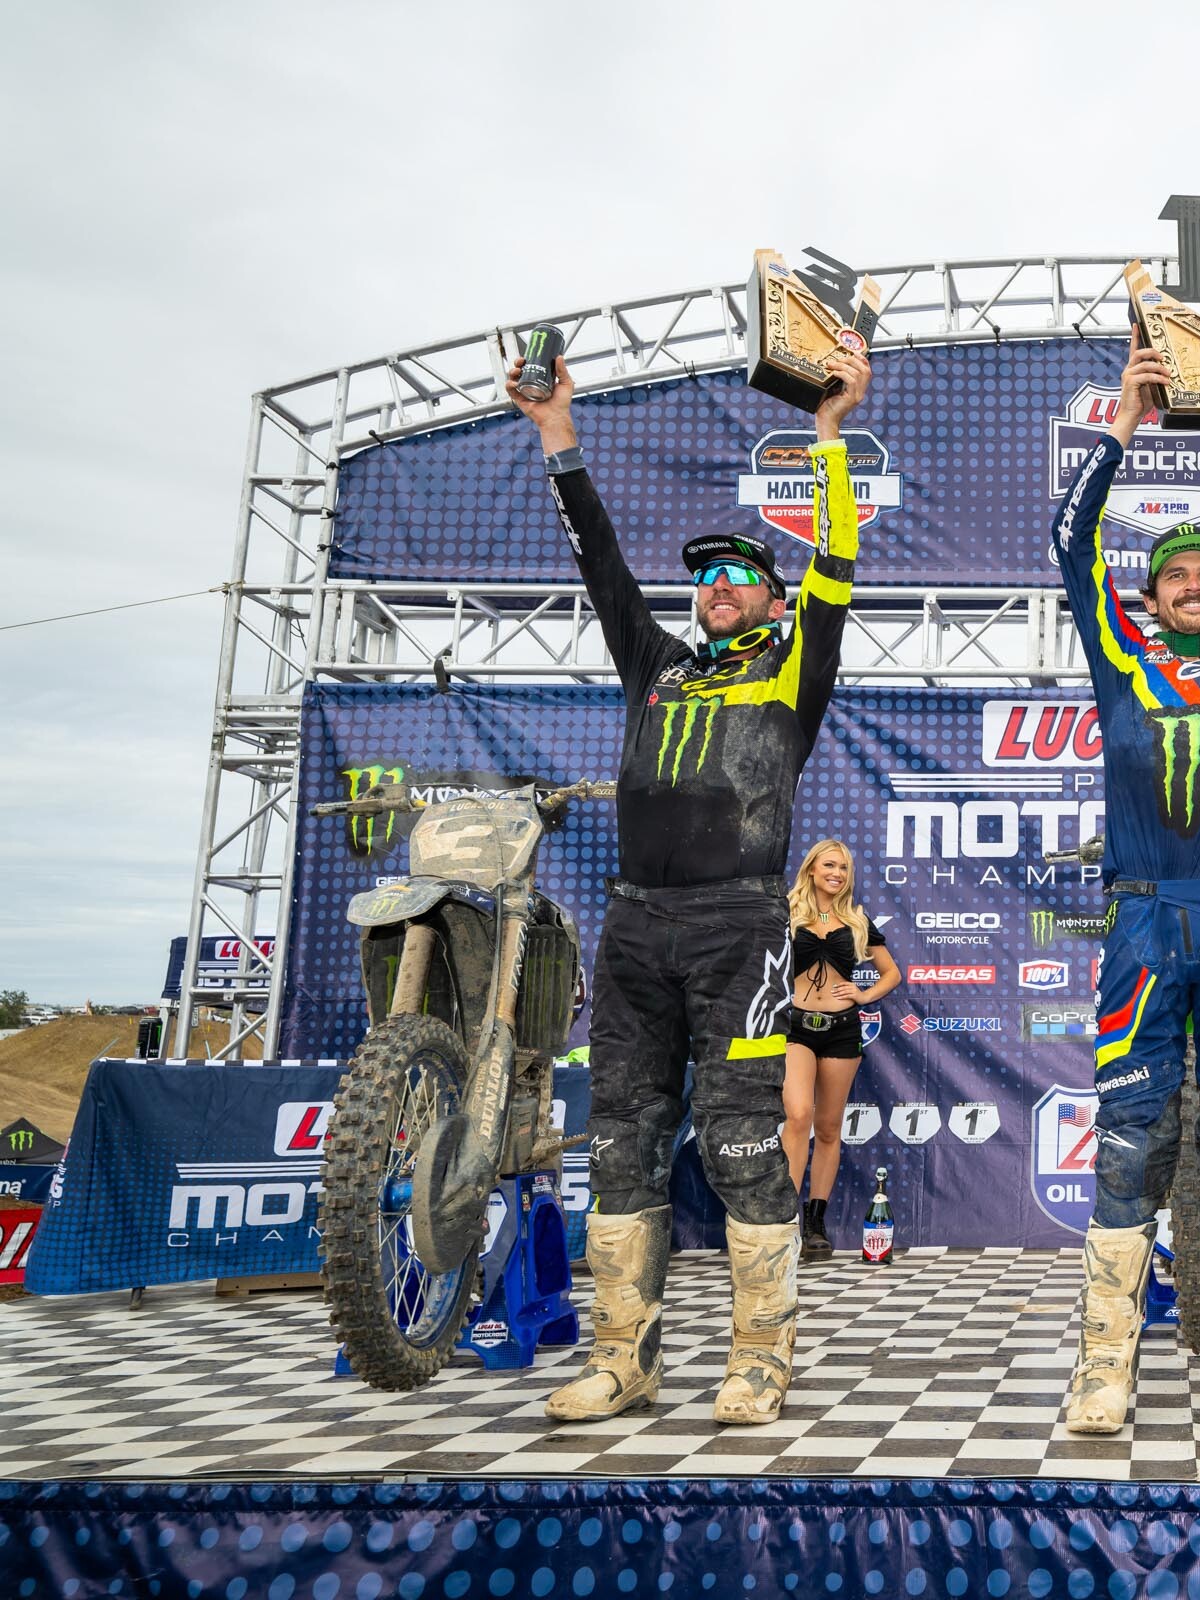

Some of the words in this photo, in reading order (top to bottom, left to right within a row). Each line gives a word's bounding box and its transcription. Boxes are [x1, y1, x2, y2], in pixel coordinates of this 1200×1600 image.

[777, 350, 824, 375] Hangtown
[1135, 441, 1185, 449] PRO
[1058, 444, 1108, 552] alpinestars
[767, 508, 814, 517] MOTOCRO
[1132, 503, 1170, 514] AMA
[1170, 503, 1190, 511] PRO
[697, 541, 732, 552] YAMAHA
[1144, 651, 1174, 661] Airoh
[995, 706, 1104, 762] LUC
[488, 802, 506, 810] OIL
[916, 912, 1000, 929] GEICO
[926, 936, 990, 945] MOTORCYCLE
[910, 968, 992, 981] GASGAS
[1025, 967, 1062, 983] 100%
[924, 1017, 1000, 1031] SUZUKI
[719, 1135, 779, 1157] ASTARS
[1046, 1185, 1089, 1202] OIL
